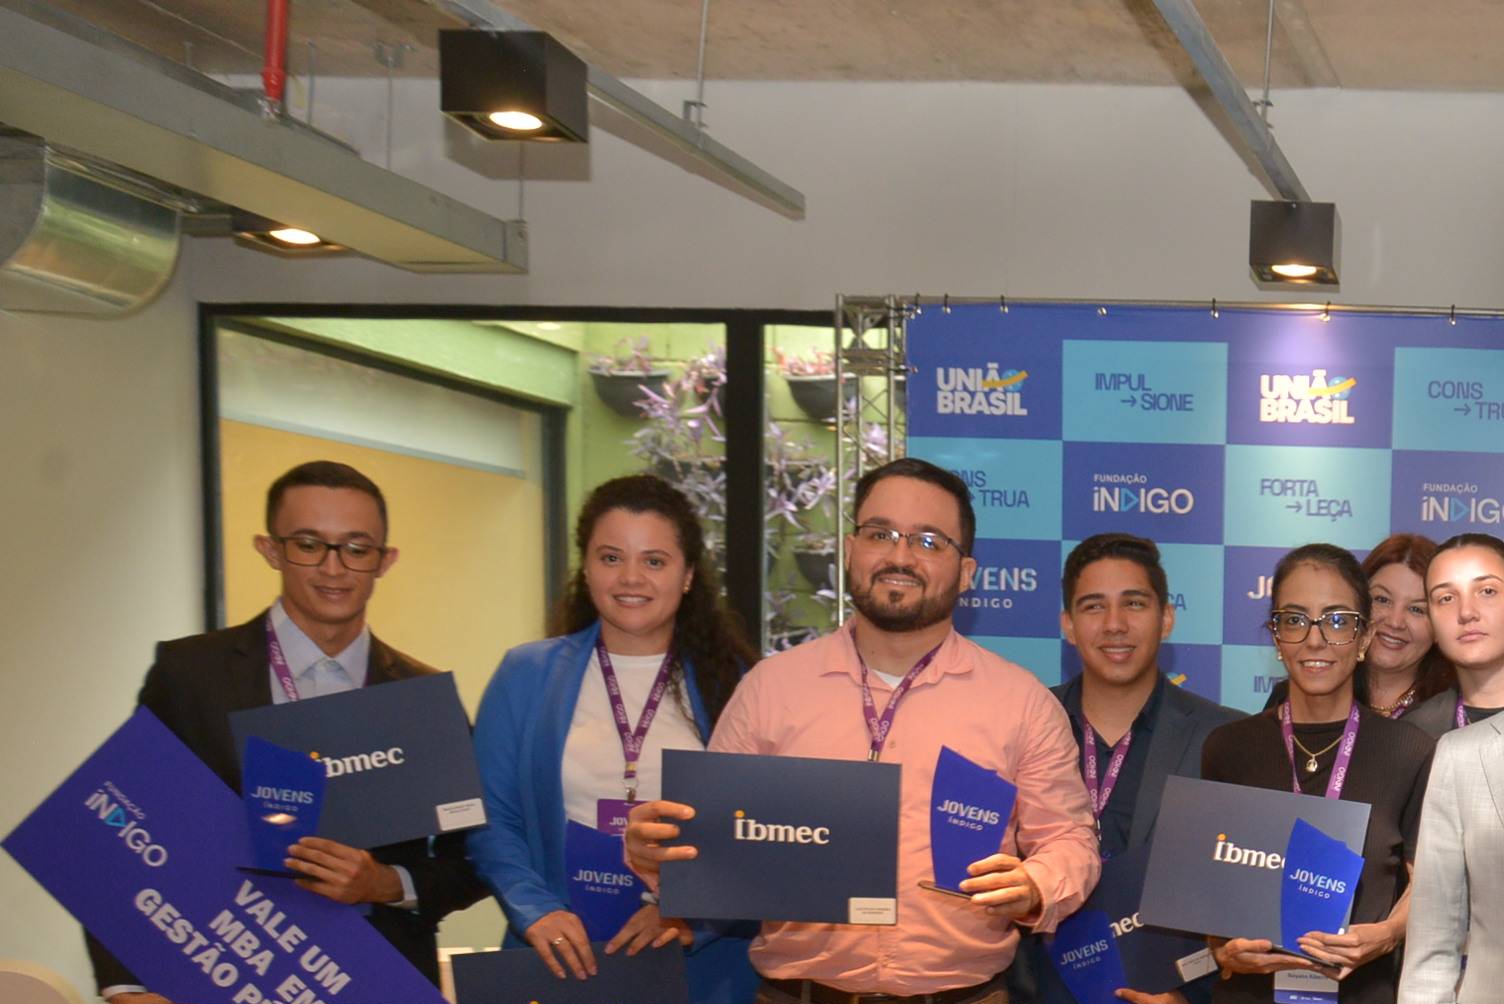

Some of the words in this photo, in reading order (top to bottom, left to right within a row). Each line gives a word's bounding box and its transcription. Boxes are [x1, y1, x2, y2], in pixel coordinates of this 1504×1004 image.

[1095, 373, 1151, 391] IMPUL
[1428, 380, 1484, 400] CONS
[937, 391, 1028, 415] BRASIL
[1141, 393, 1194, 412] SIONE
[1260, 399, 1355, 424] BRASIL
[1093, 473, 1147, 484] FUNDAÇÃO
[1260, 479, 1319, 497] FORTA
[1423, 483, 1478, 493] FUNDAÇÃO
[978, 489, 1030, 508] TRUA
[1306, 499, 1352, 521] LEÇA
[959, 597, 1013, 609] NDIGO
[251, 785, 314, 805] JOVENS
[936, 800, 1000, 825] JOVENS
[735, 810, 830, 844] ibmec
[1213, 833, 1286, 869] ibme
[573, 870, 634, 887] JOVENS
[1289, 868, 1347, 893] JOVENS
[134, 888, 239, 988] GESTÃO
[209, 909, 274, 976] MBA
[234, 879, 308, 953] VALE
[299, 945, 352, 995] UM
[1060, 939, 1109, 965] JOVENS
